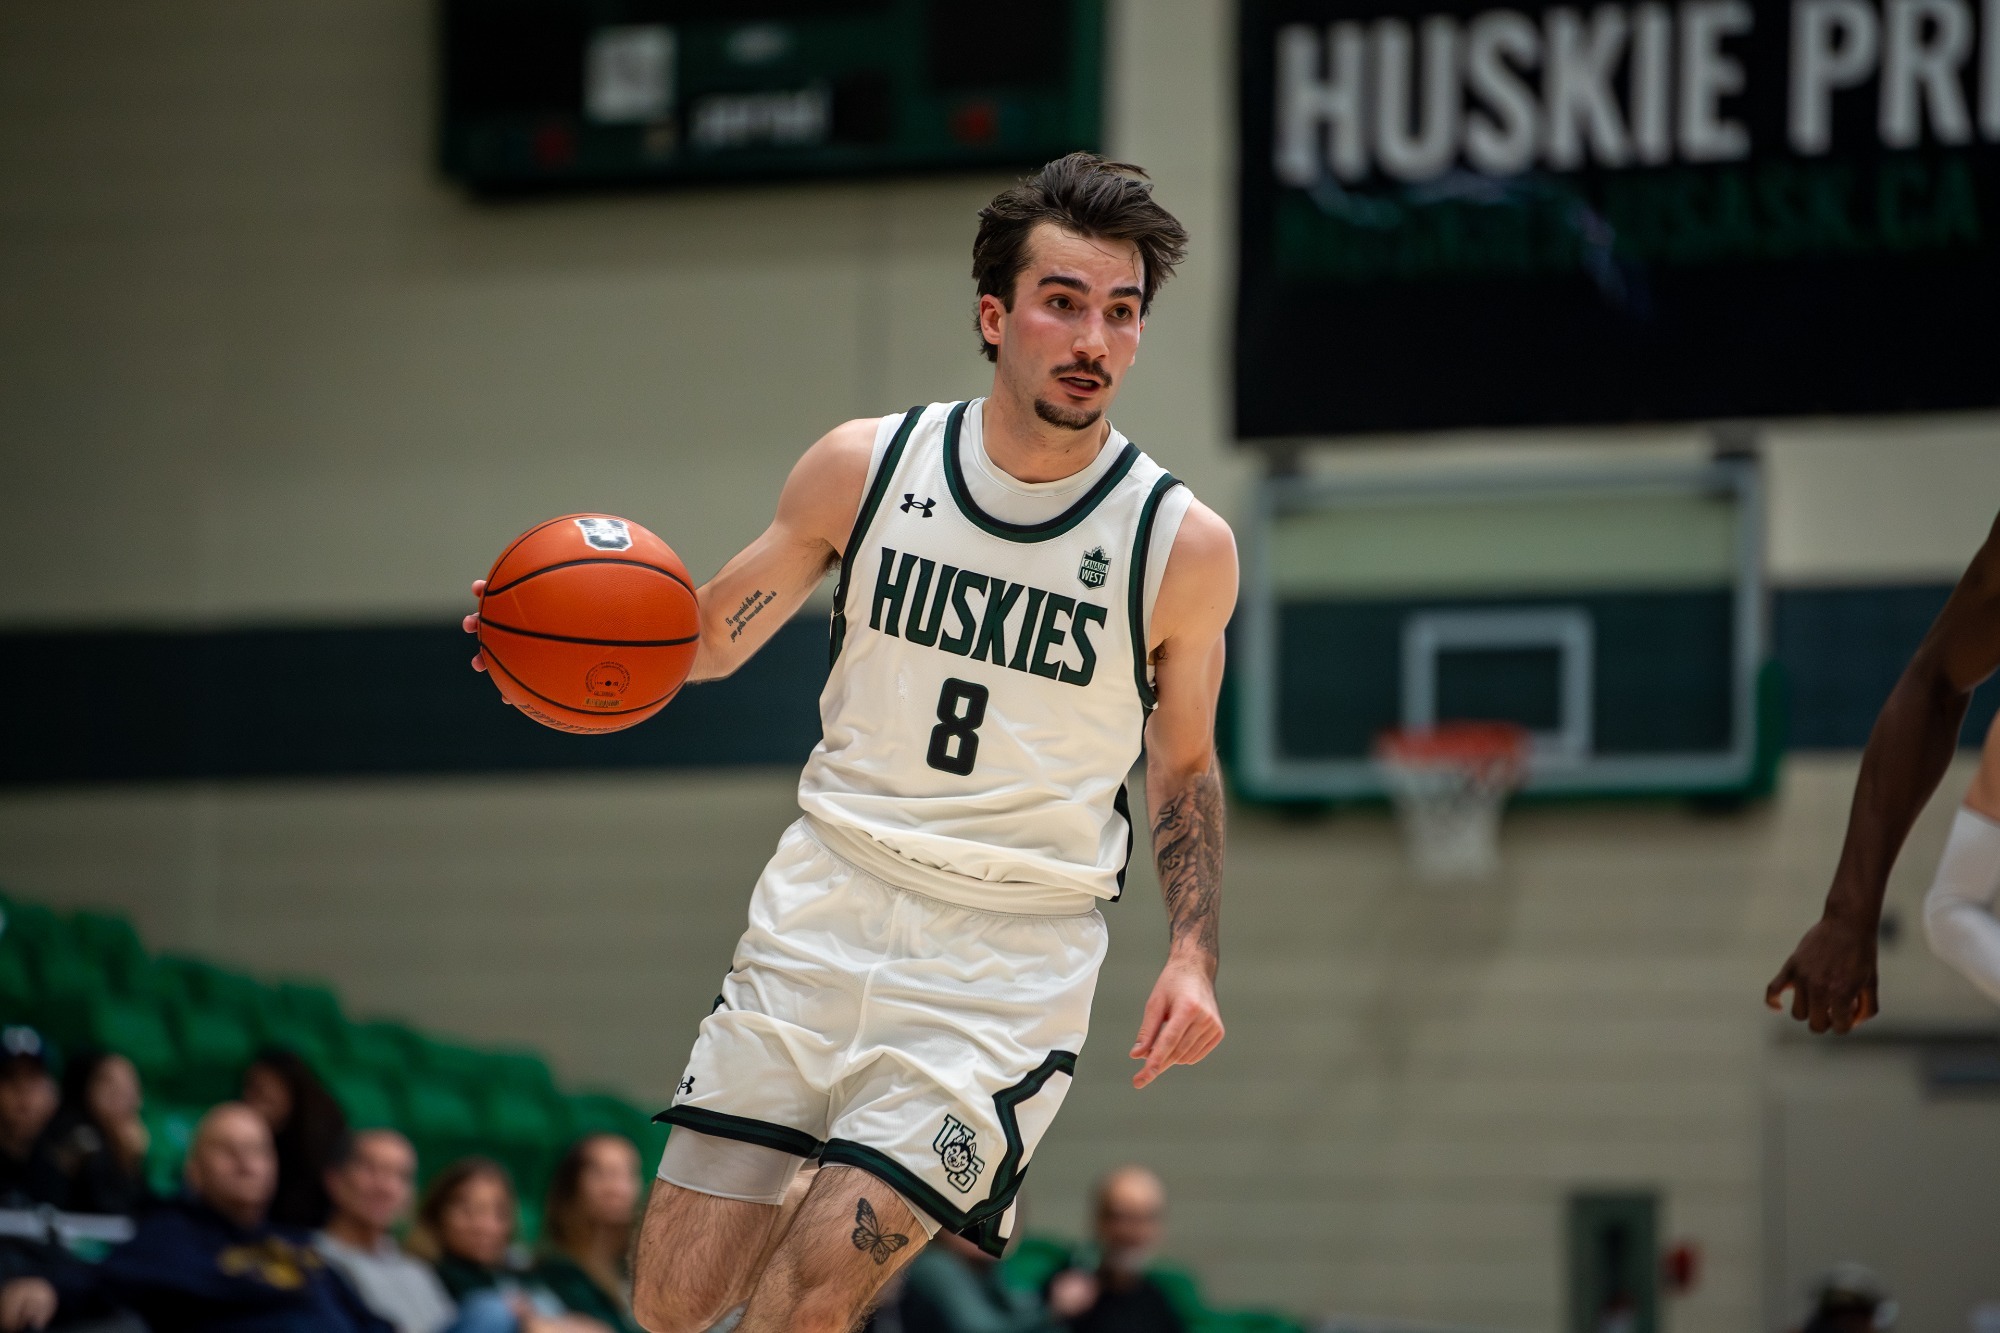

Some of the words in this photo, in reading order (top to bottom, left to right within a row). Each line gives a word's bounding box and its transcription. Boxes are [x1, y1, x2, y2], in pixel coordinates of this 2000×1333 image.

[1275, 4, 1752, 186] HUSKIE
[1081, 568, 1105, 585] WEST
[1083, 559, 1107, 573] CANADA
[869, 546, 1108, 687] HUSKIES
[926, 677, 989, 777] 8
